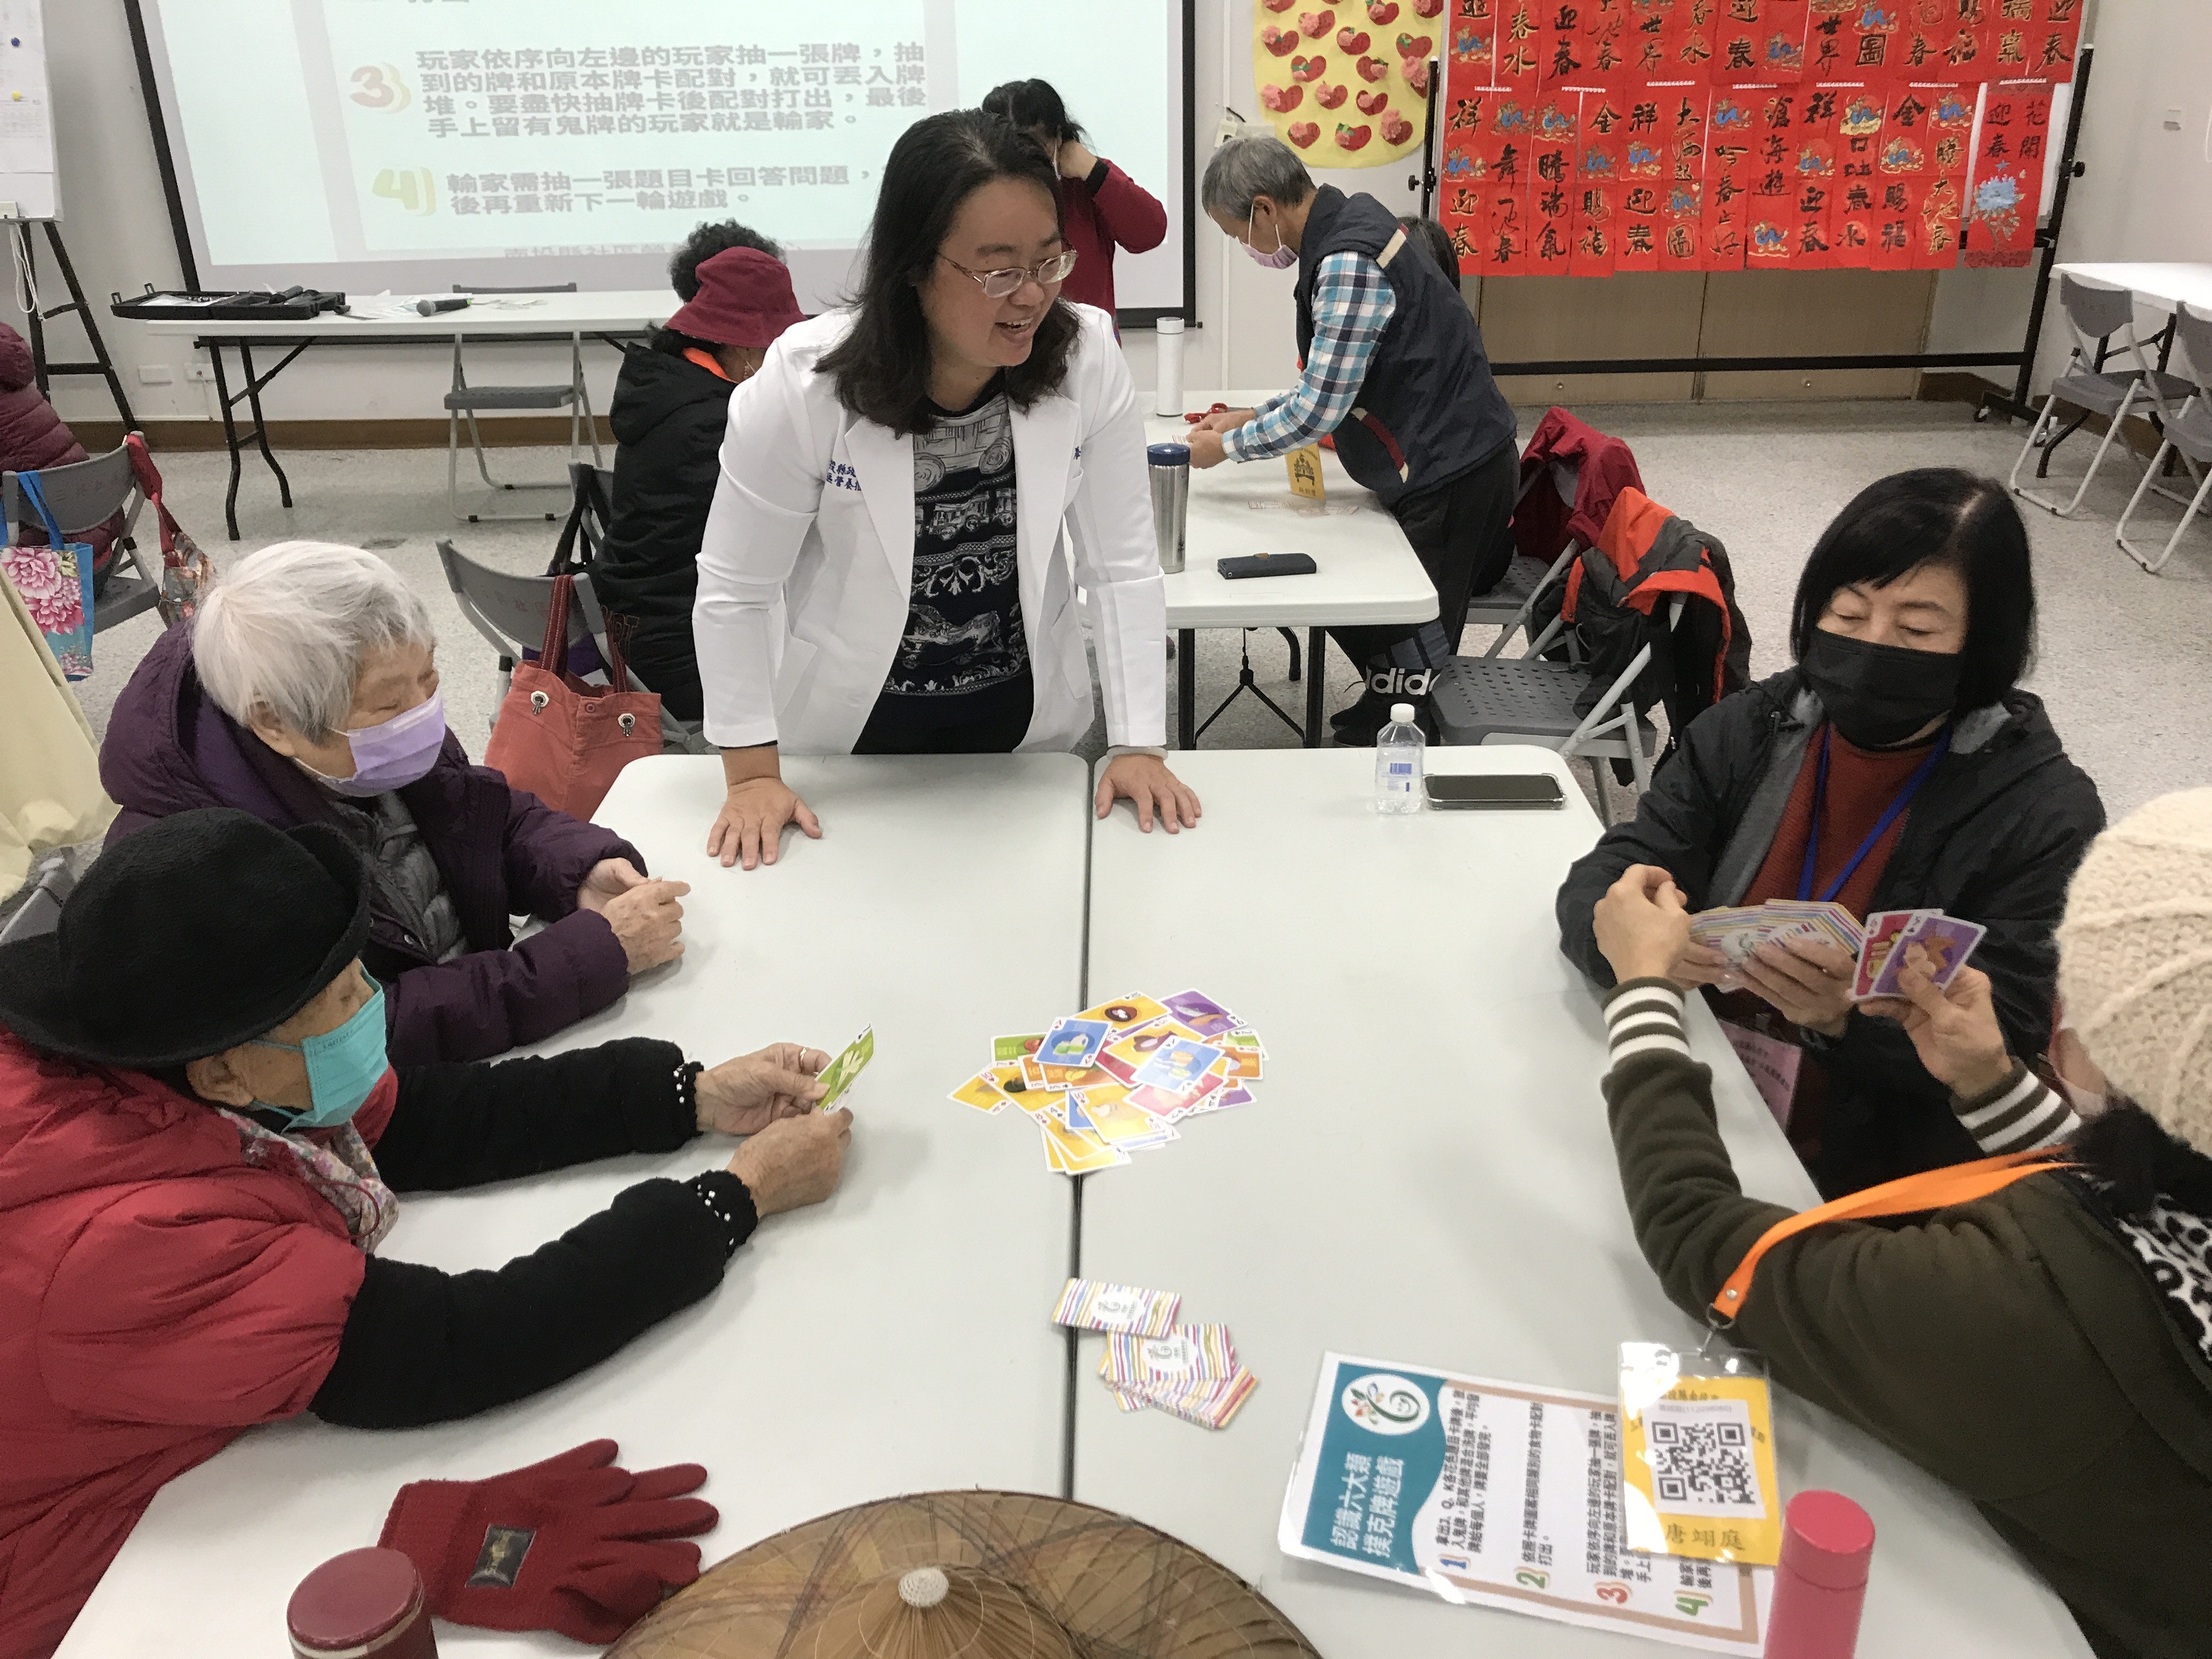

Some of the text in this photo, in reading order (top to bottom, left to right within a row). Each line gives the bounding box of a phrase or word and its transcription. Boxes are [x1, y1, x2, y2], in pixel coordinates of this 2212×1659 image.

[446, 165, 884, 193] 輸家需抽一張題目卡回答問題，
[1365, 665, 1441, 696] did
[1330, 1452, 1372, 1550] 認識六大類
